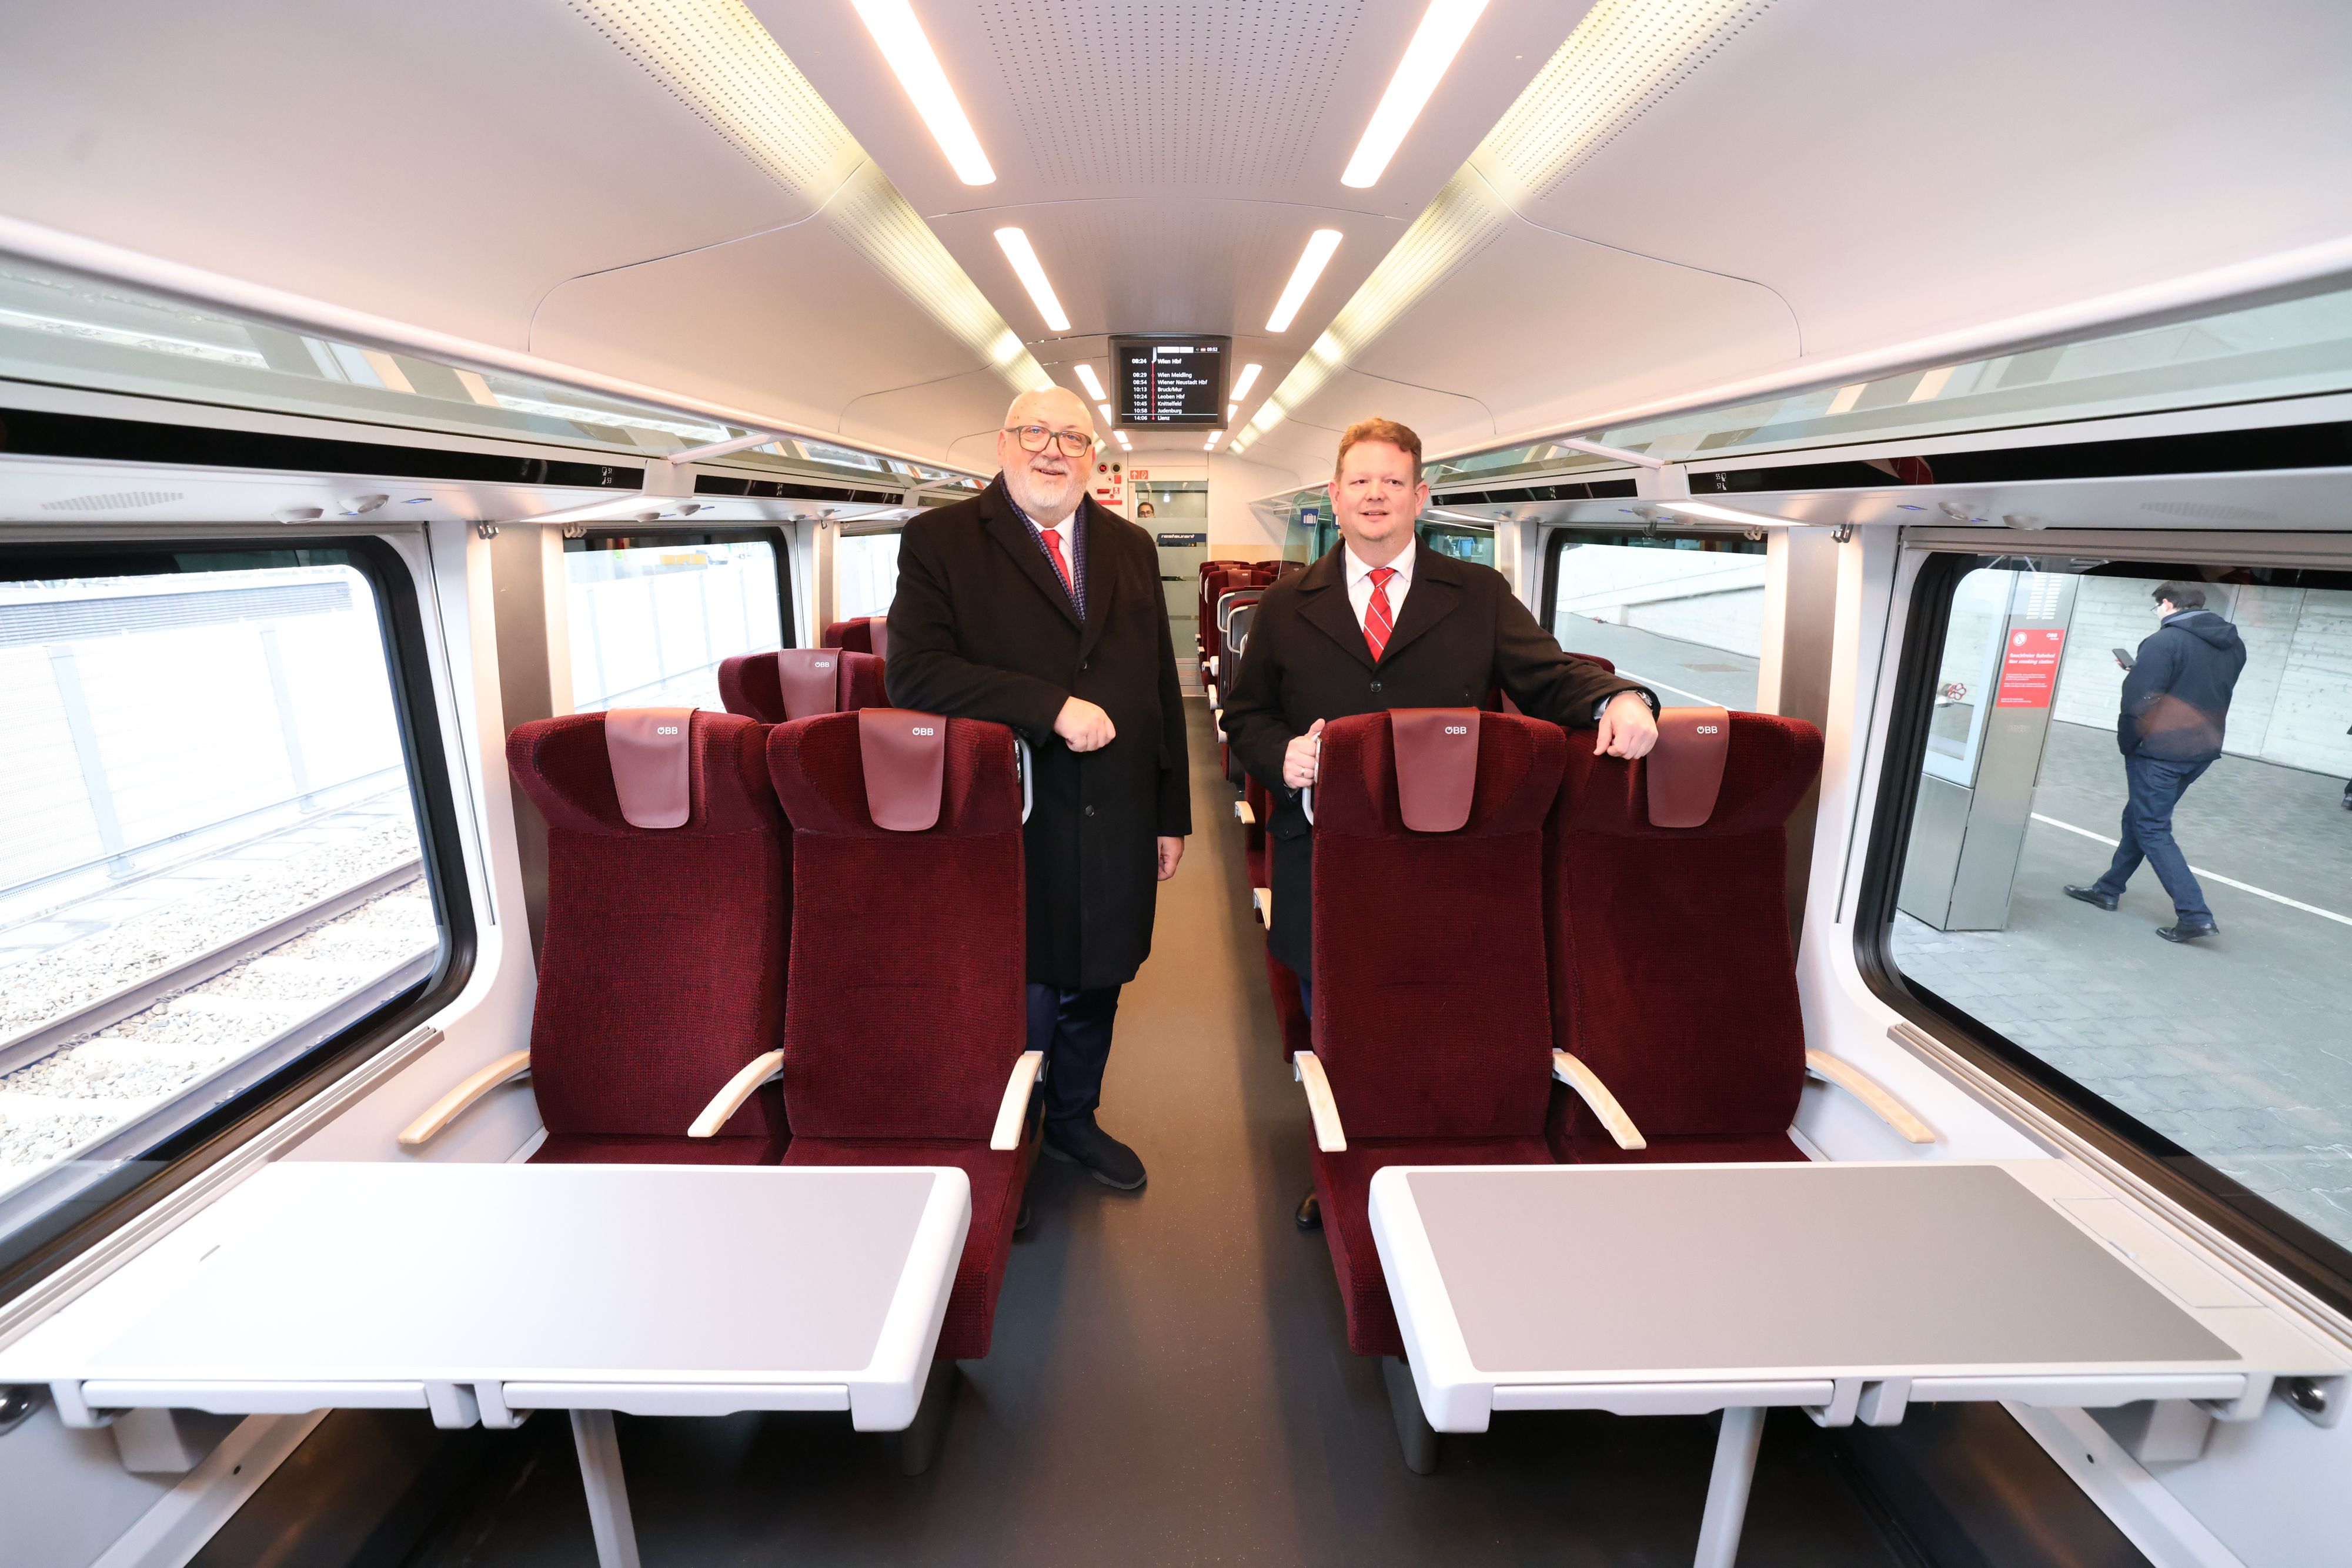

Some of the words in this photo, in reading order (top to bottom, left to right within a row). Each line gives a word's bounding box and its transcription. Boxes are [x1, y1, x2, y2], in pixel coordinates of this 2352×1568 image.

[657, 727, 678, 735] ÖBB
[912, 727, 933, 735] ÖBB
[1445, 726, 1466, 734] ÖBB
[1697, 726, 1718, 734] ÖBB
